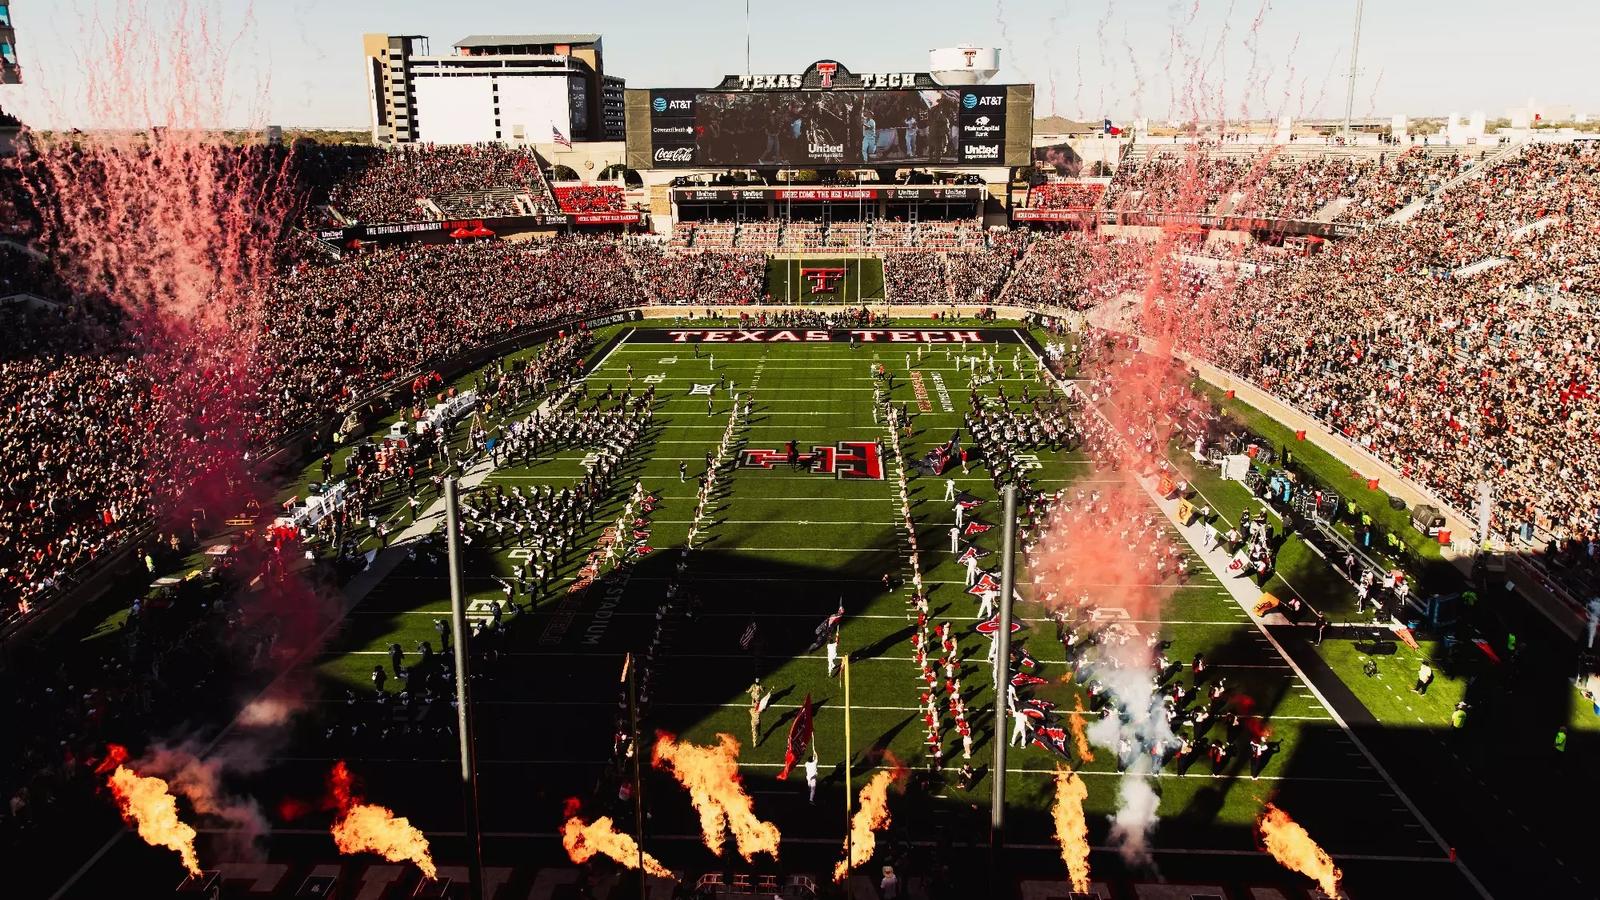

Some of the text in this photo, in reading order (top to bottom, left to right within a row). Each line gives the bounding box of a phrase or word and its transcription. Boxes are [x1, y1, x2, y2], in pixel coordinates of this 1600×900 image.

[738, 73, 915, 89] TEXAS TECH
[669, 100, 693, 109] AT&T
[979, 96, 1004, 106] AT&T
[808, 143, 844, 154] United
[965, 144, 999, 155] United
[968, 175, 979, 183] 25
[782, 190, 798, 199] HERE
[799, 190, 815, 199] COME
[816, 190, 829, 199] THE
[366, 227, 377, 236] THE
[378, 224, 402, 234] OFFICIAL
[402, 221, 442, 233] SUPERMARKET
[669, 329, 982, 342] TEXAS TECH
